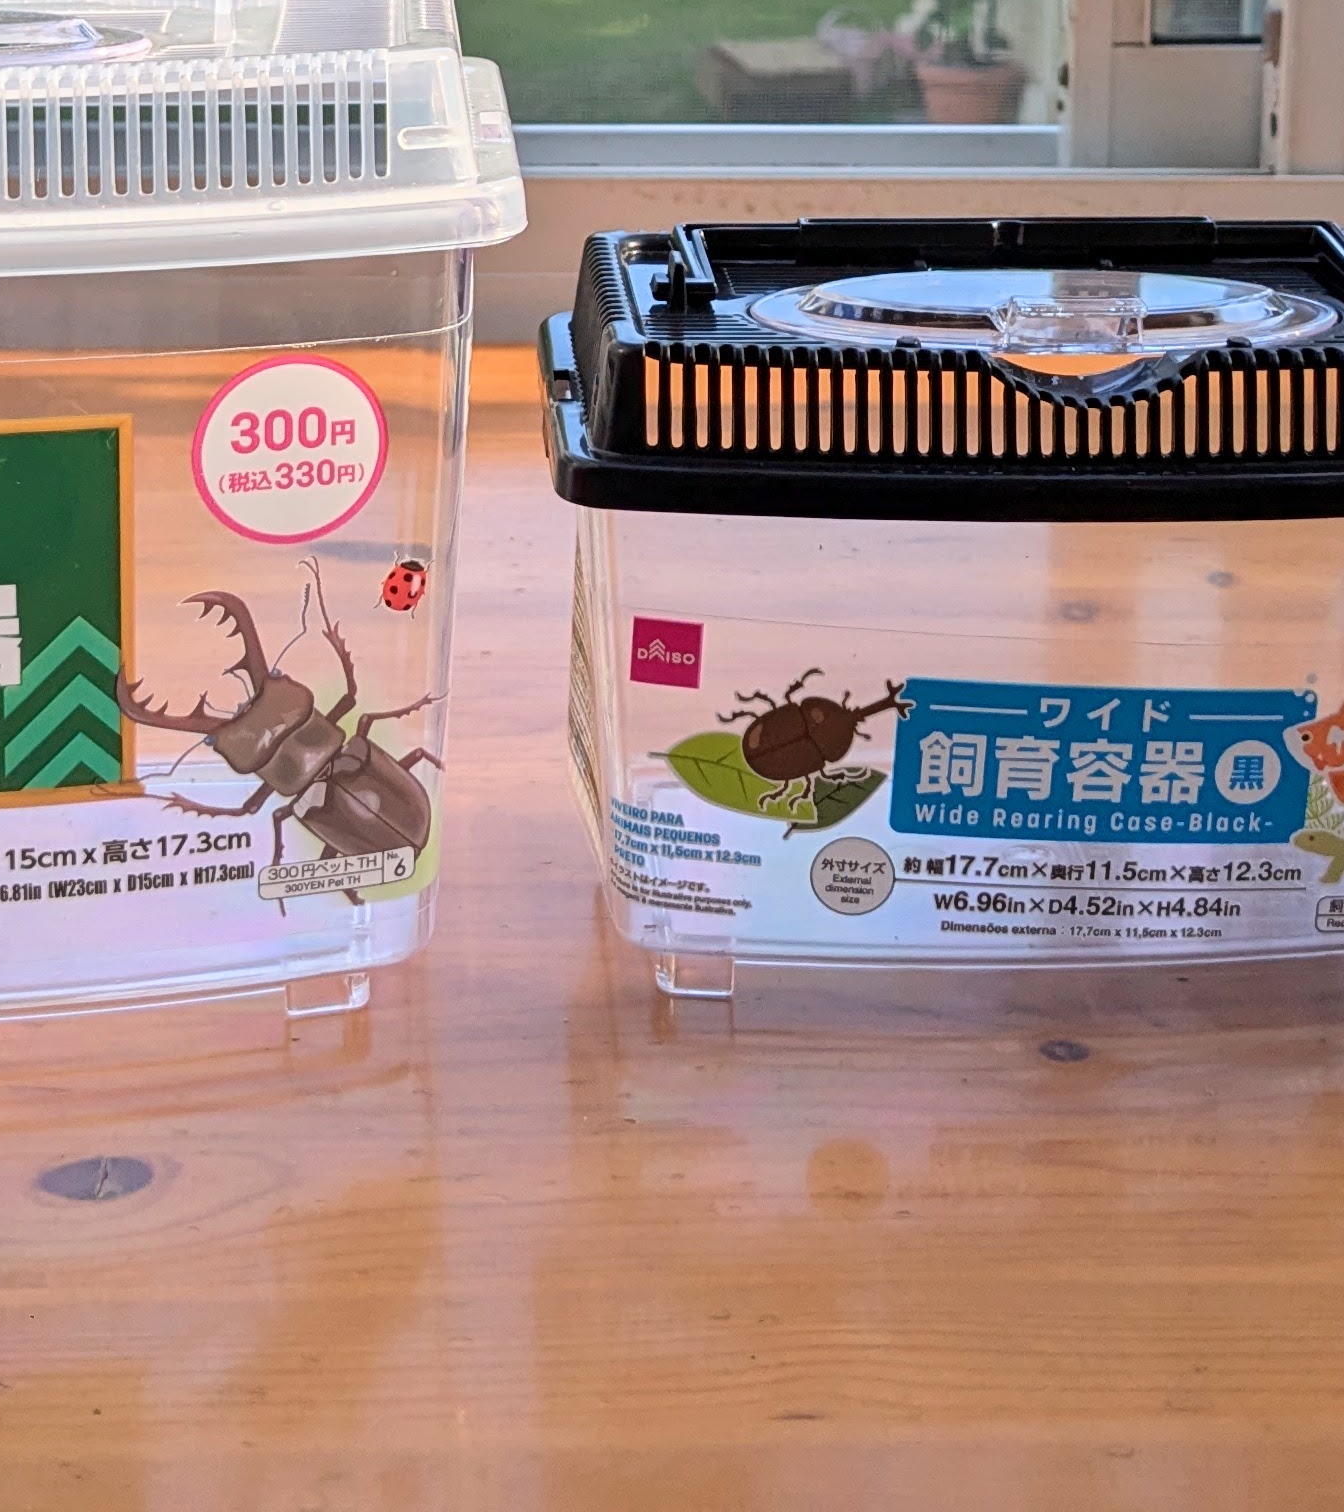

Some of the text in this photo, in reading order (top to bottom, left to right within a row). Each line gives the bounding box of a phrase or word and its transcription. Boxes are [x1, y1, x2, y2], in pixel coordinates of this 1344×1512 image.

[230, 406, 356, 455] 300円
[218, 458, 366, 494] (税込330円)
[637, 637, 696, 667] DAISO
[1038, 696, 1173, 734] ワイド
[914, 730, 1207, 806] 飼育容器
[1227, 753, 1267, 792] 黒
[650, 810, 685, 828] PARA
[914, 802, 981, 826] Wide
[992, 808, 1098, 836] Rearing
[654, 826, 722, 847] PEQUENOS
[614, 844, 646, 868] PRETO
[661, 842, 703, 861] 11,5cm
[393, 857, 407, 878] 6
[820, 857, 887, 875] 外寸サイズ
[113, 877, 122, 893] x
[127, 872, 175, 892] D15cm
[179, 870, 189, 887] x
[284, 874, 362, 894] 300YEN Pet TH
[940, 920, 1009, 935] Dimensões
